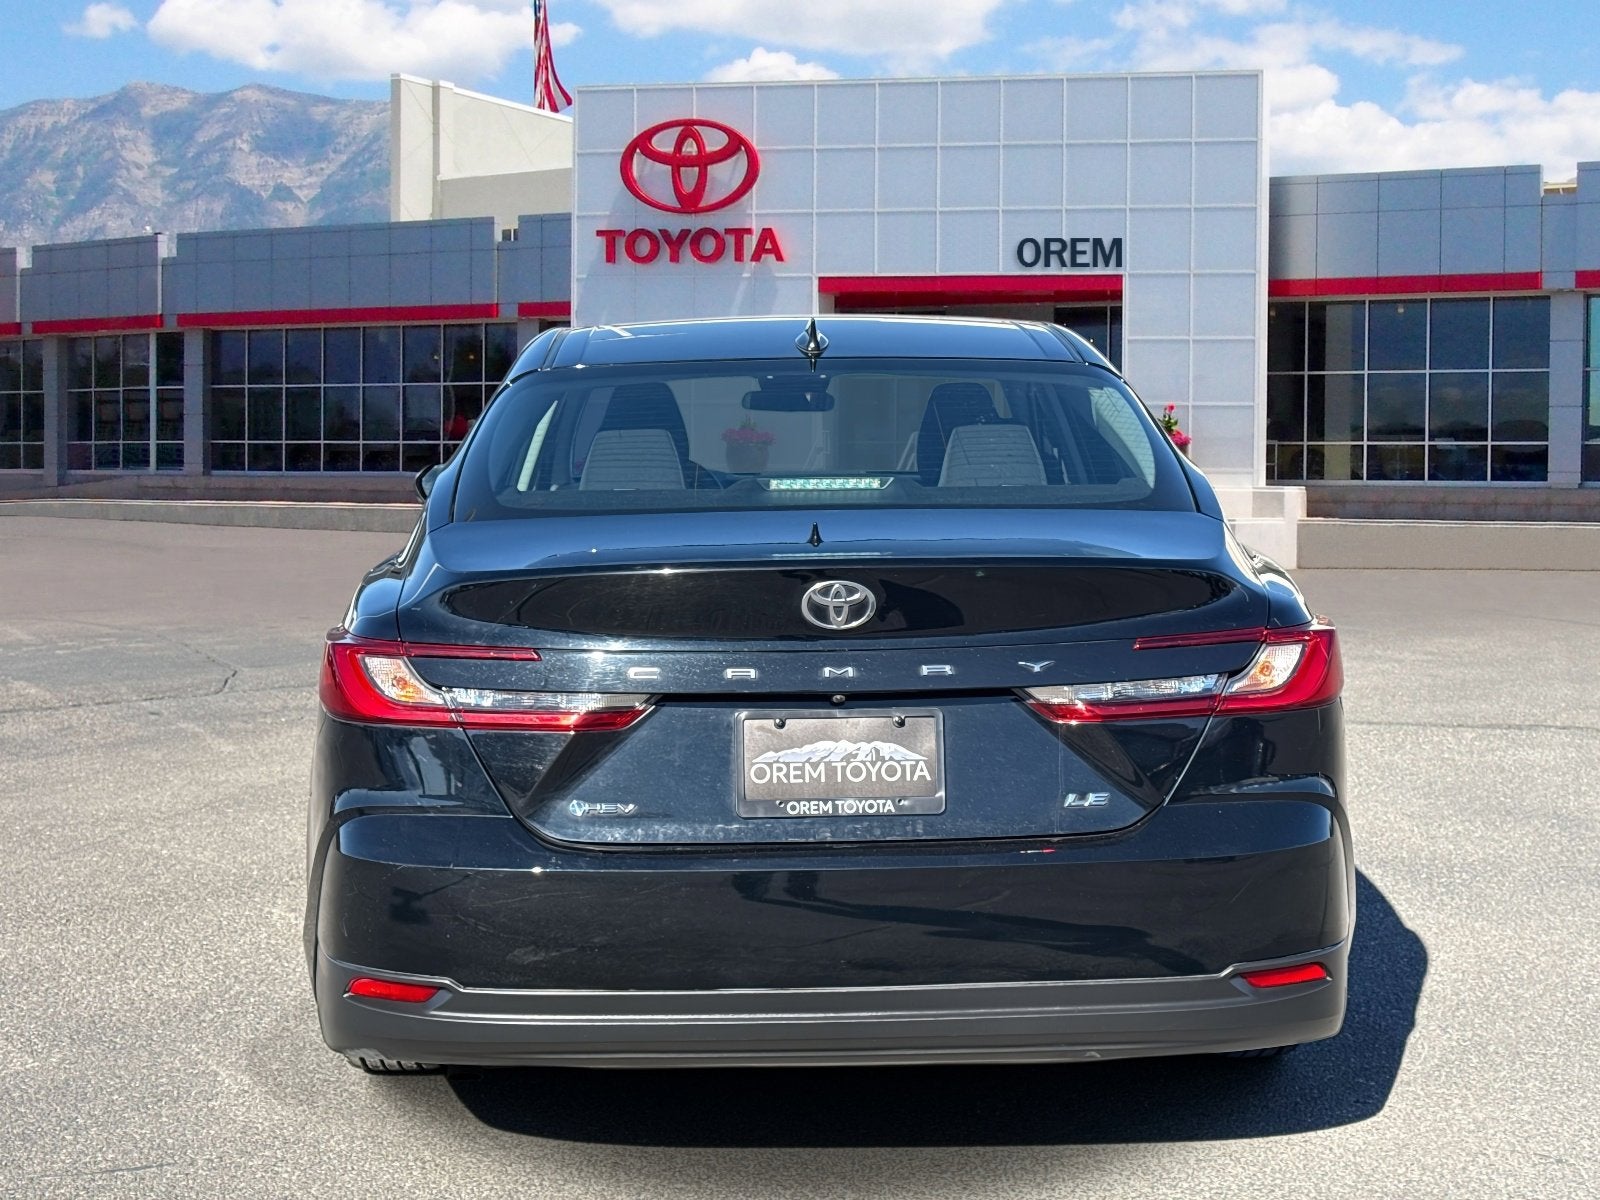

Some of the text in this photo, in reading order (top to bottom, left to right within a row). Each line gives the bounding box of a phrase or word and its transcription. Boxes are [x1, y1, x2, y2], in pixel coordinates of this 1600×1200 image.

[596, 227, 785, 264] TOYOTA
[1016, 237, 1123, 269] OREM
[628, 659, 1055, 680] CAMRY
[750, 760, 932, 784] OREM TOYOTA
[786, 799, 896, 815] OREM TOYOTA
[1063, 792, 1110, 808] LE
